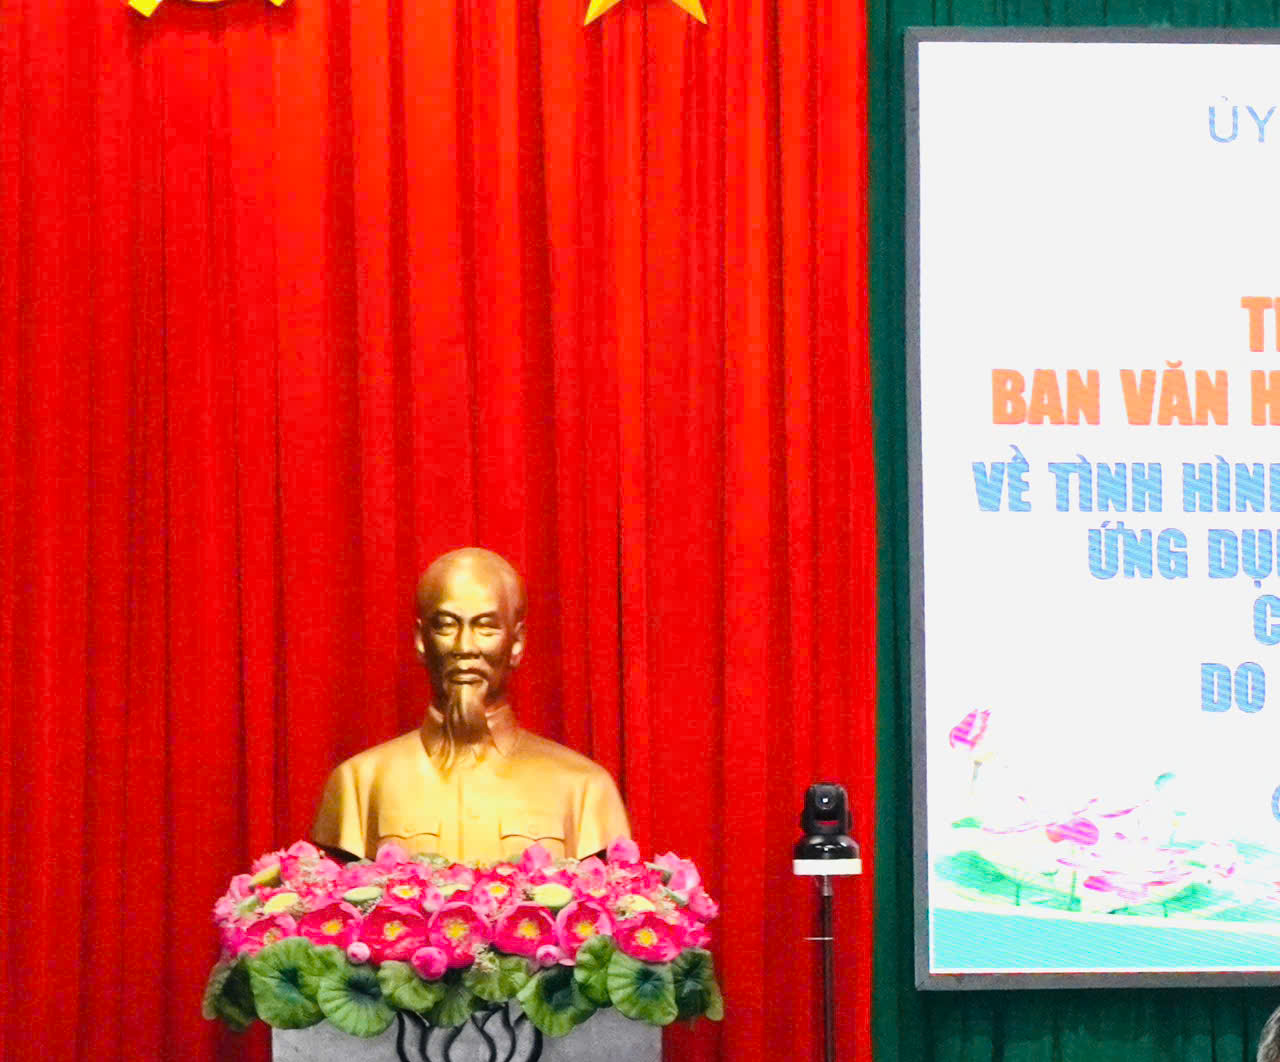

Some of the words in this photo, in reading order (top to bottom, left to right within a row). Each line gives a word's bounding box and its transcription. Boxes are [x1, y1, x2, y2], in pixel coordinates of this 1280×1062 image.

[1208, 96, 1276, 143] ỦY
[992, 368, 1101, 426] BAN
[1120, 360, 1229, 426] VĂN
[972, 445, 1032, 512] VỀ
[1048, 454, 1163, 512] TÌNH
[1088, 520, 1191, 580] ỨNG
[1200, 662, 1266, 713] DO
